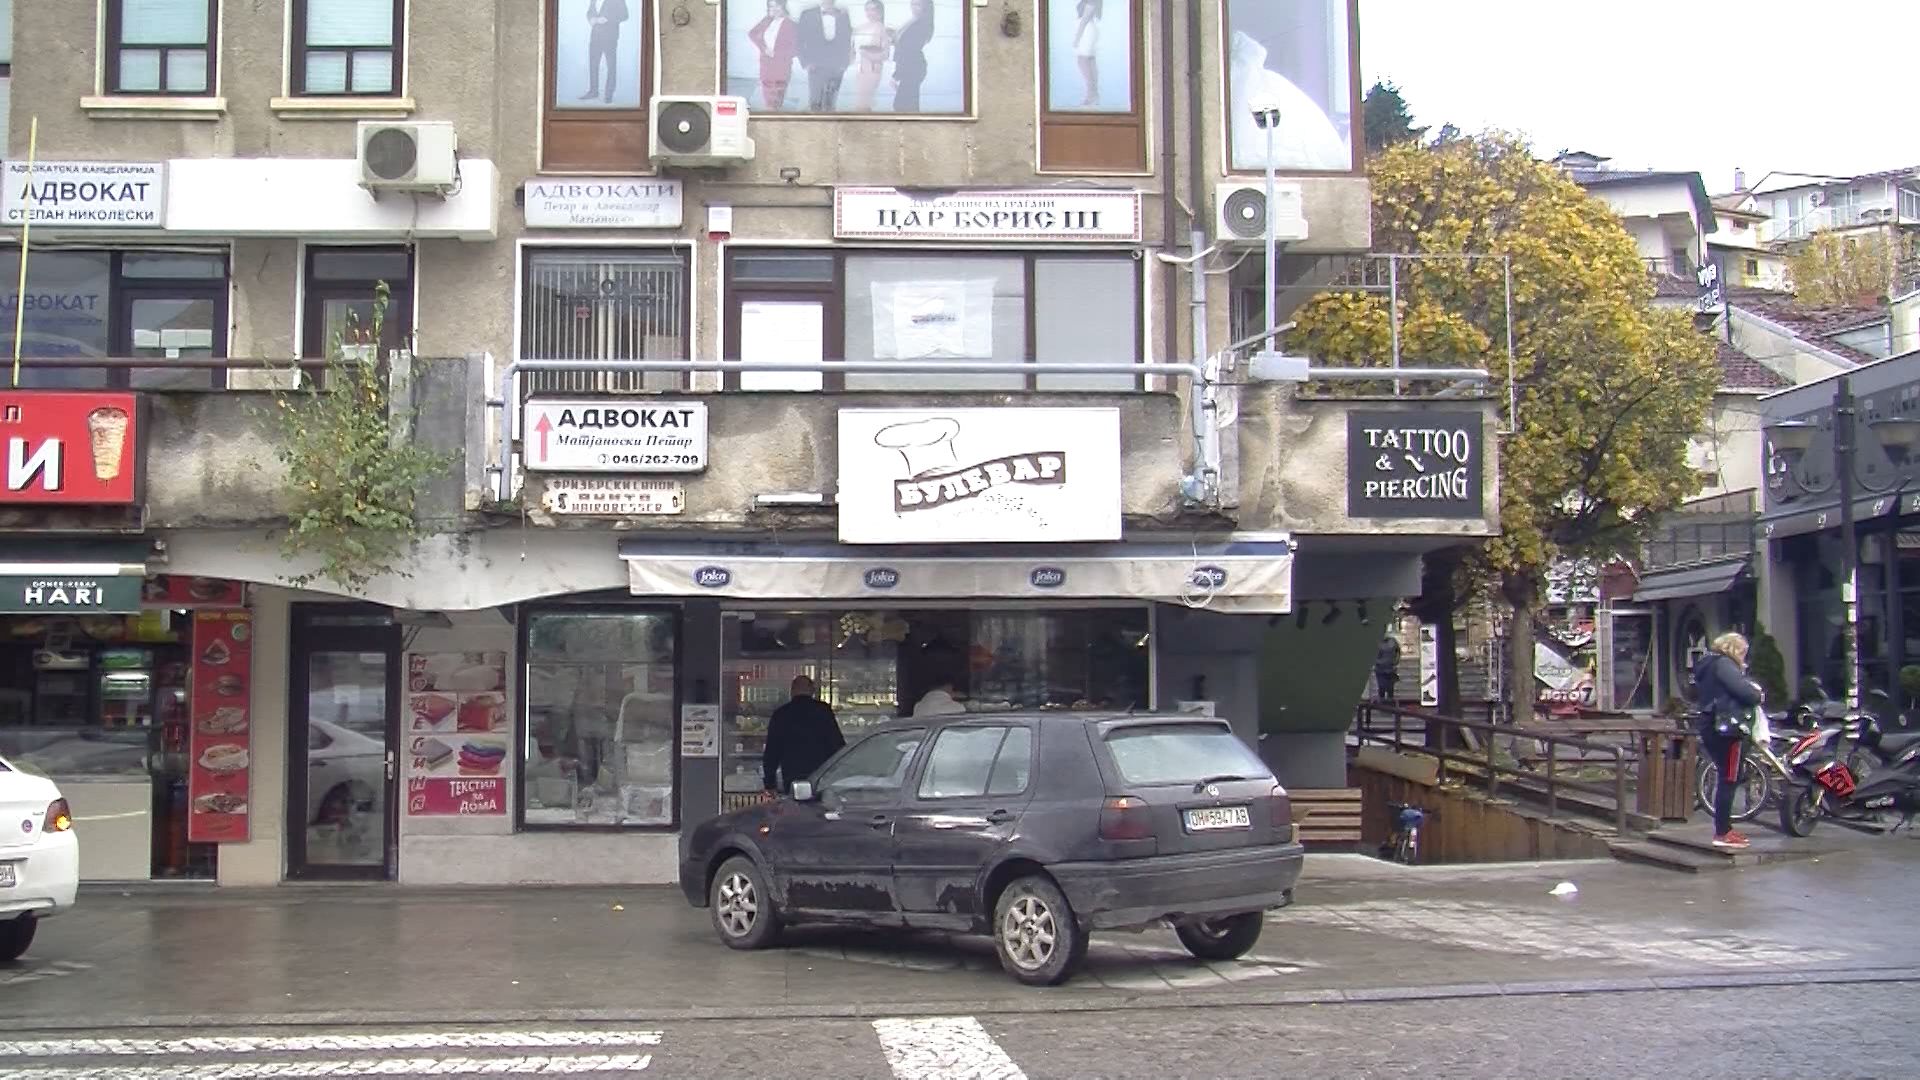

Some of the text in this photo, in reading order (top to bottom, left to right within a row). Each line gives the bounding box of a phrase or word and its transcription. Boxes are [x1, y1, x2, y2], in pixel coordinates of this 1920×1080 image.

[20, 182, 151, 205] АДВОКАТ
[531, 185, 675, 198] АДВОКАТИ
[8, 209, 154, 221] СТЕПАН НИКОЛЕСКИ
[877, 209, 944, 231] ЦАР
[954, 210, 1056, 230] БОРИС
[557, 408, 695, 430] АДВОКАТ
[1363, 429, 1470, 463] TATTOO
[1375, 453, 1395, 471] &
[896, 456, 1062, 506] БУЛЕВАР
[1365, 467, 1469, 499] PIERCING
[25, 587, 104, 605] HARI
[459, 799, 497, 815] ДОМА
